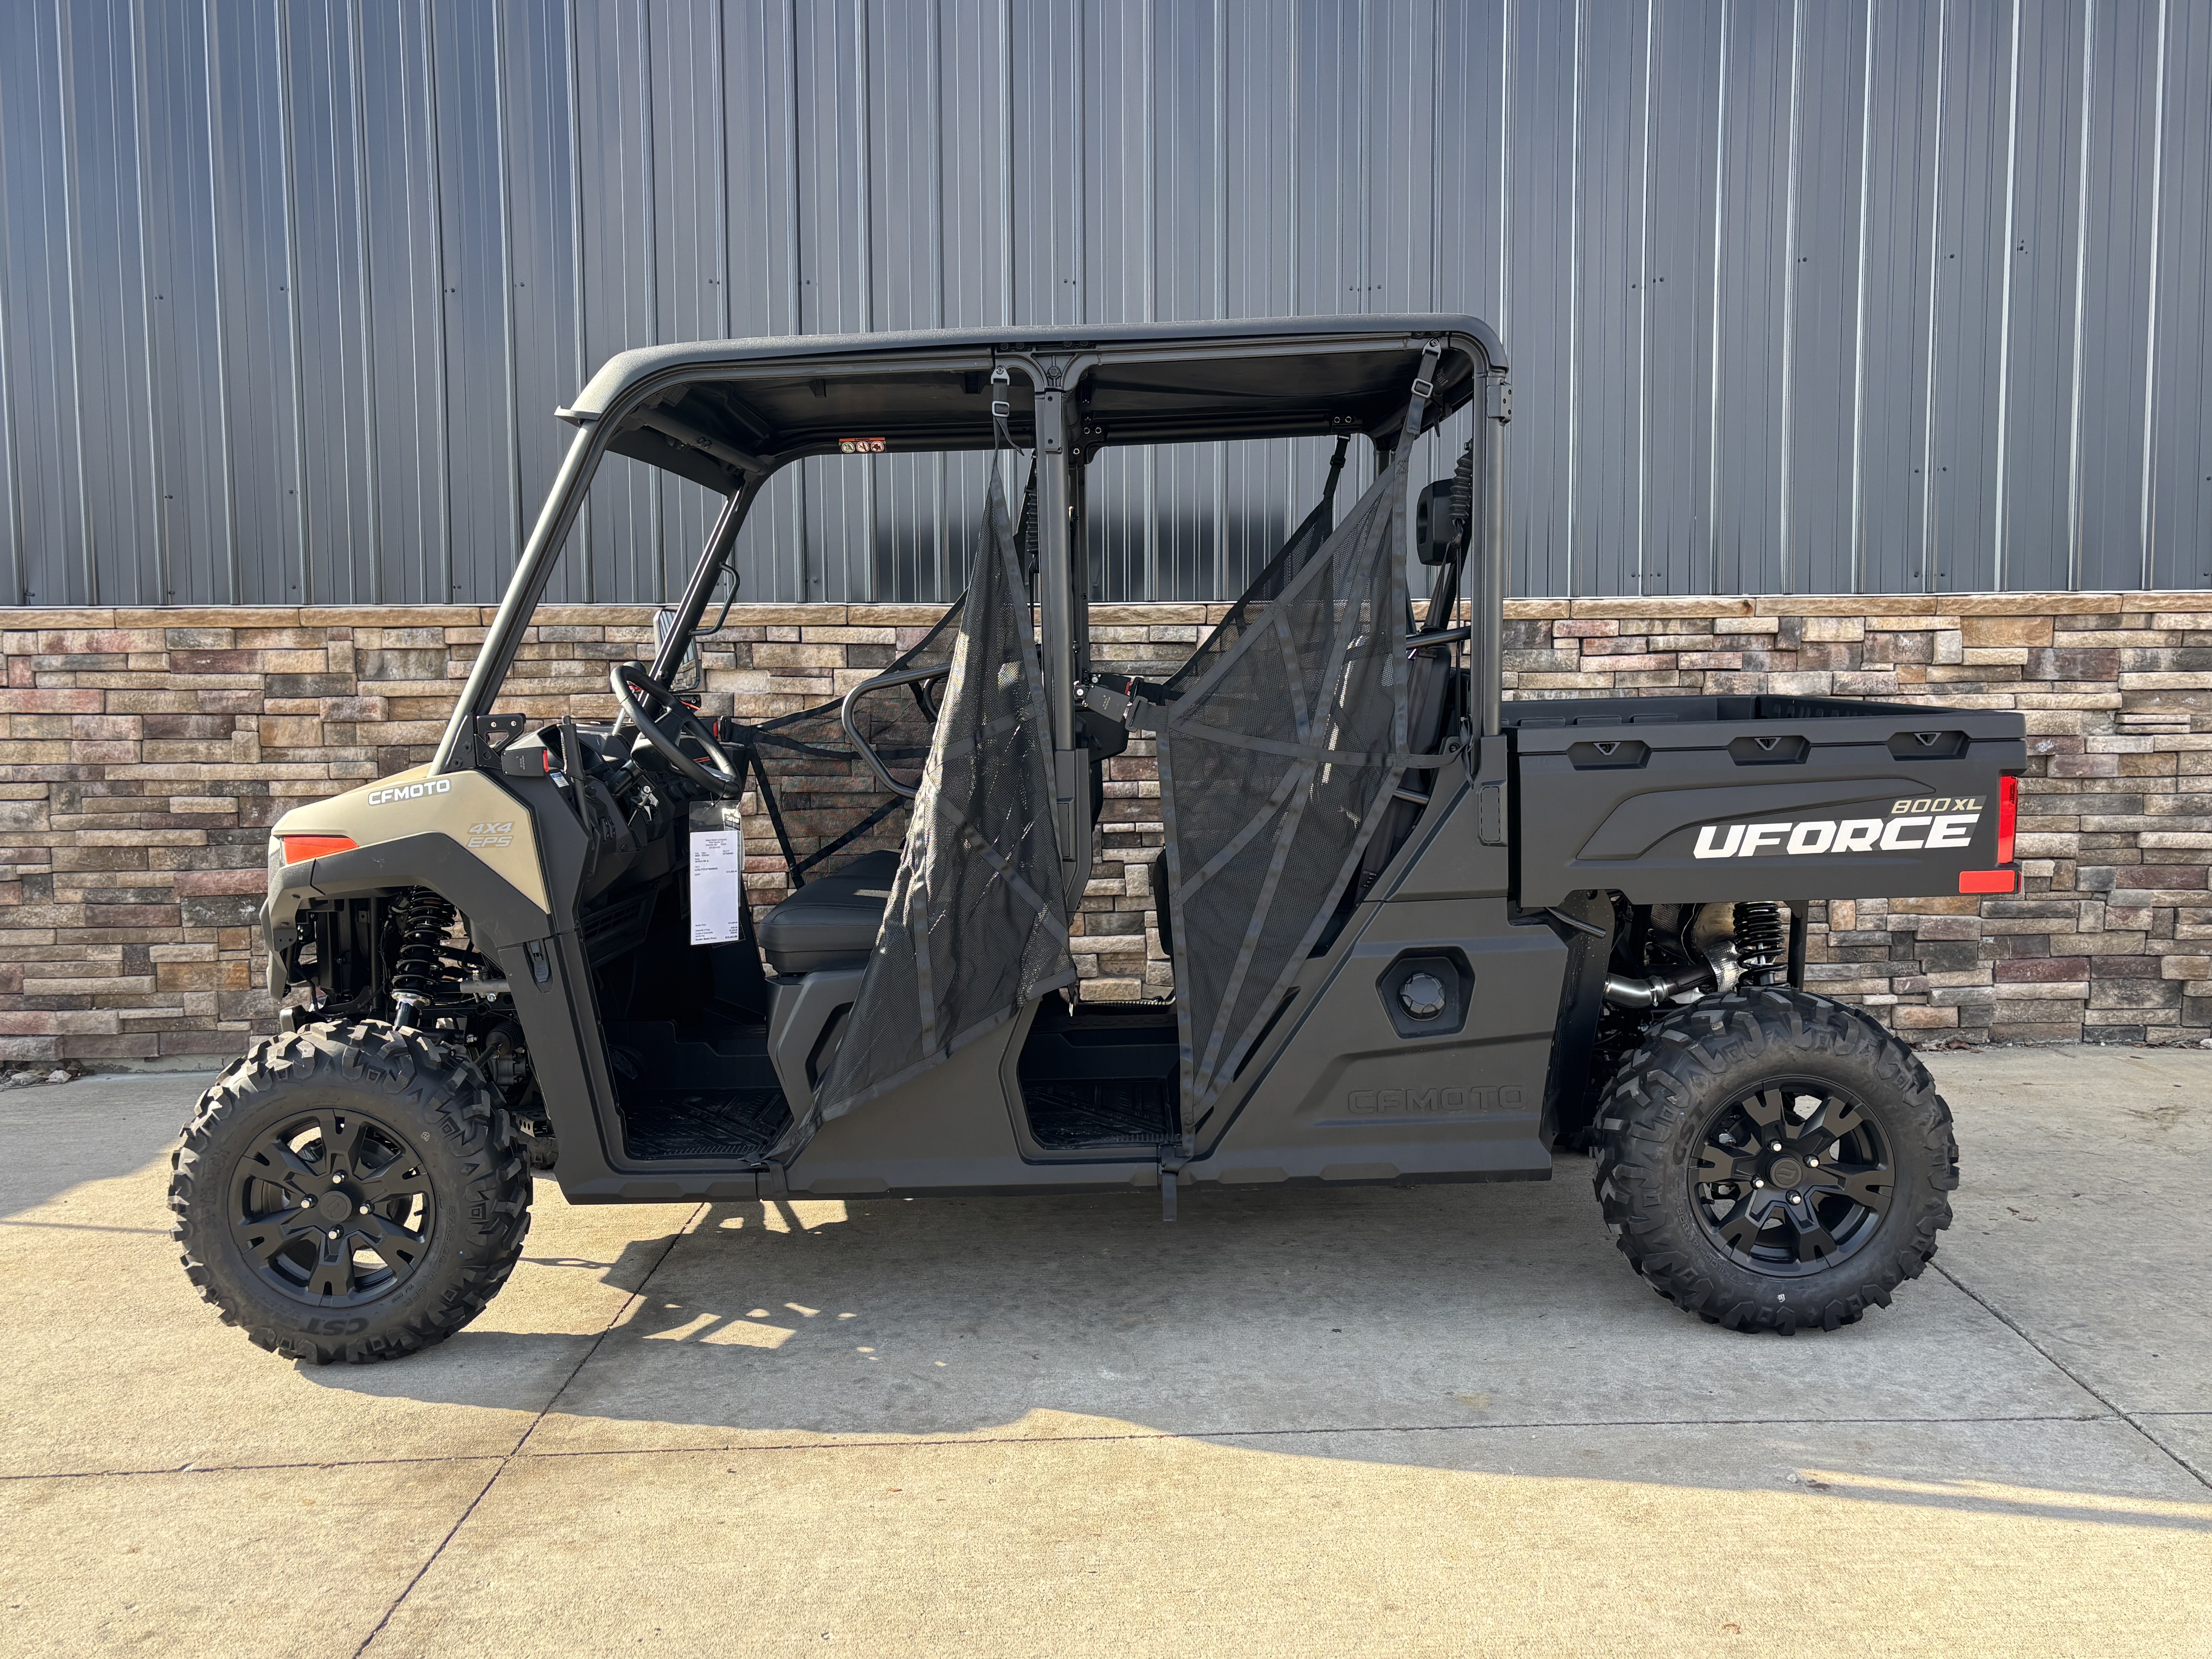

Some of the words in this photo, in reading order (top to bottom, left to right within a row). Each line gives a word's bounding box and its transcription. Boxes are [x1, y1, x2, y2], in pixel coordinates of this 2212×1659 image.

[368, 779, 450, 805] CFMOTO
[467, 836, 513, 848] EPS
[1693, 813, 1980, 859] UFORCE
[1348, 1085, 1527, 1114] CFMOTO
[298, 1317, 369, 1336] CST
